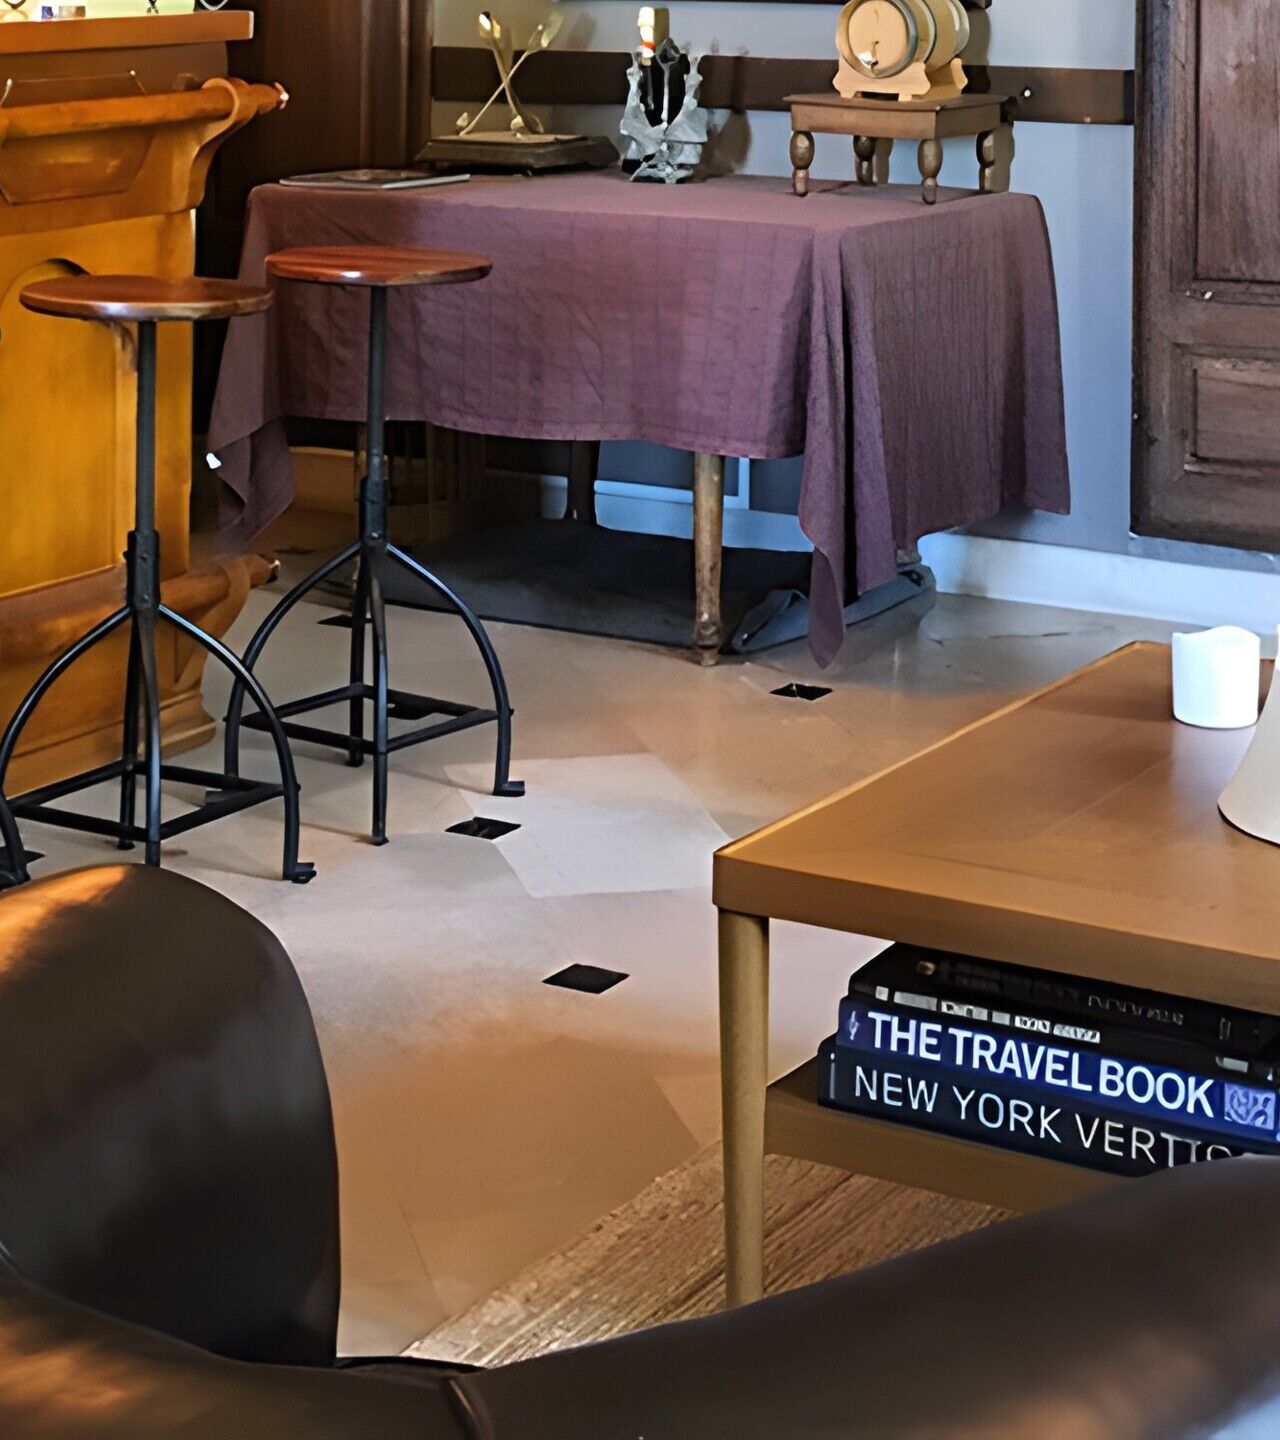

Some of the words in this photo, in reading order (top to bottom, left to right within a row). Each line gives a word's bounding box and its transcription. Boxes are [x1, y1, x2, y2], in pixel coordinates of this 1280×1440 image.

[854, 1065, 939, 1114] NEW
[952, 1085, 1063, 1144] YORK
[867, 1010, 942, 1062] THE
[948, 1027, 1093, 1093] TRAVEL
[1099, 1057, 1215, 1118] BOOK
